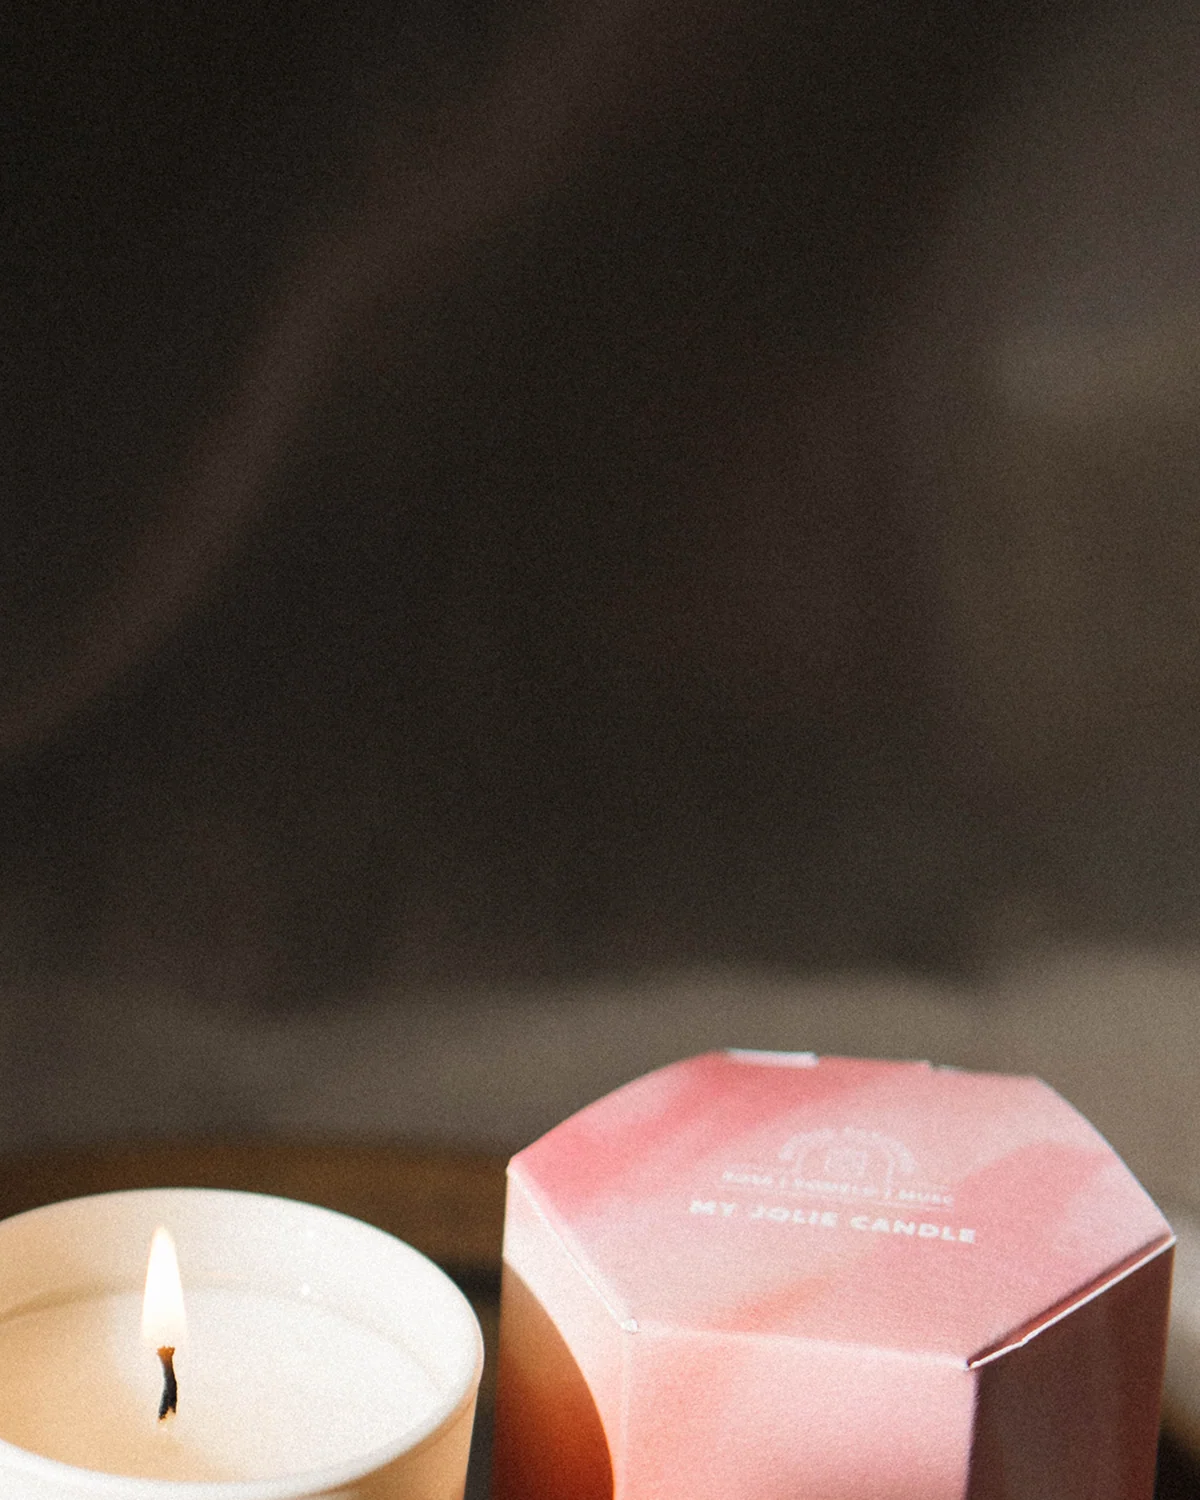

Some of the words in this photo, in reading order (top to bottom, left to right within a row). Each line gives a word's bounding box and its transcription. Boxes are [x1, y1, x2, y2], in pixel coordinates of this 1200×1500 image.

[688, 1199, 737, 1217] MY
[749, 1204, 838, 1229] JOLIE
[850, 1214, 977, 1245] CANDLE
